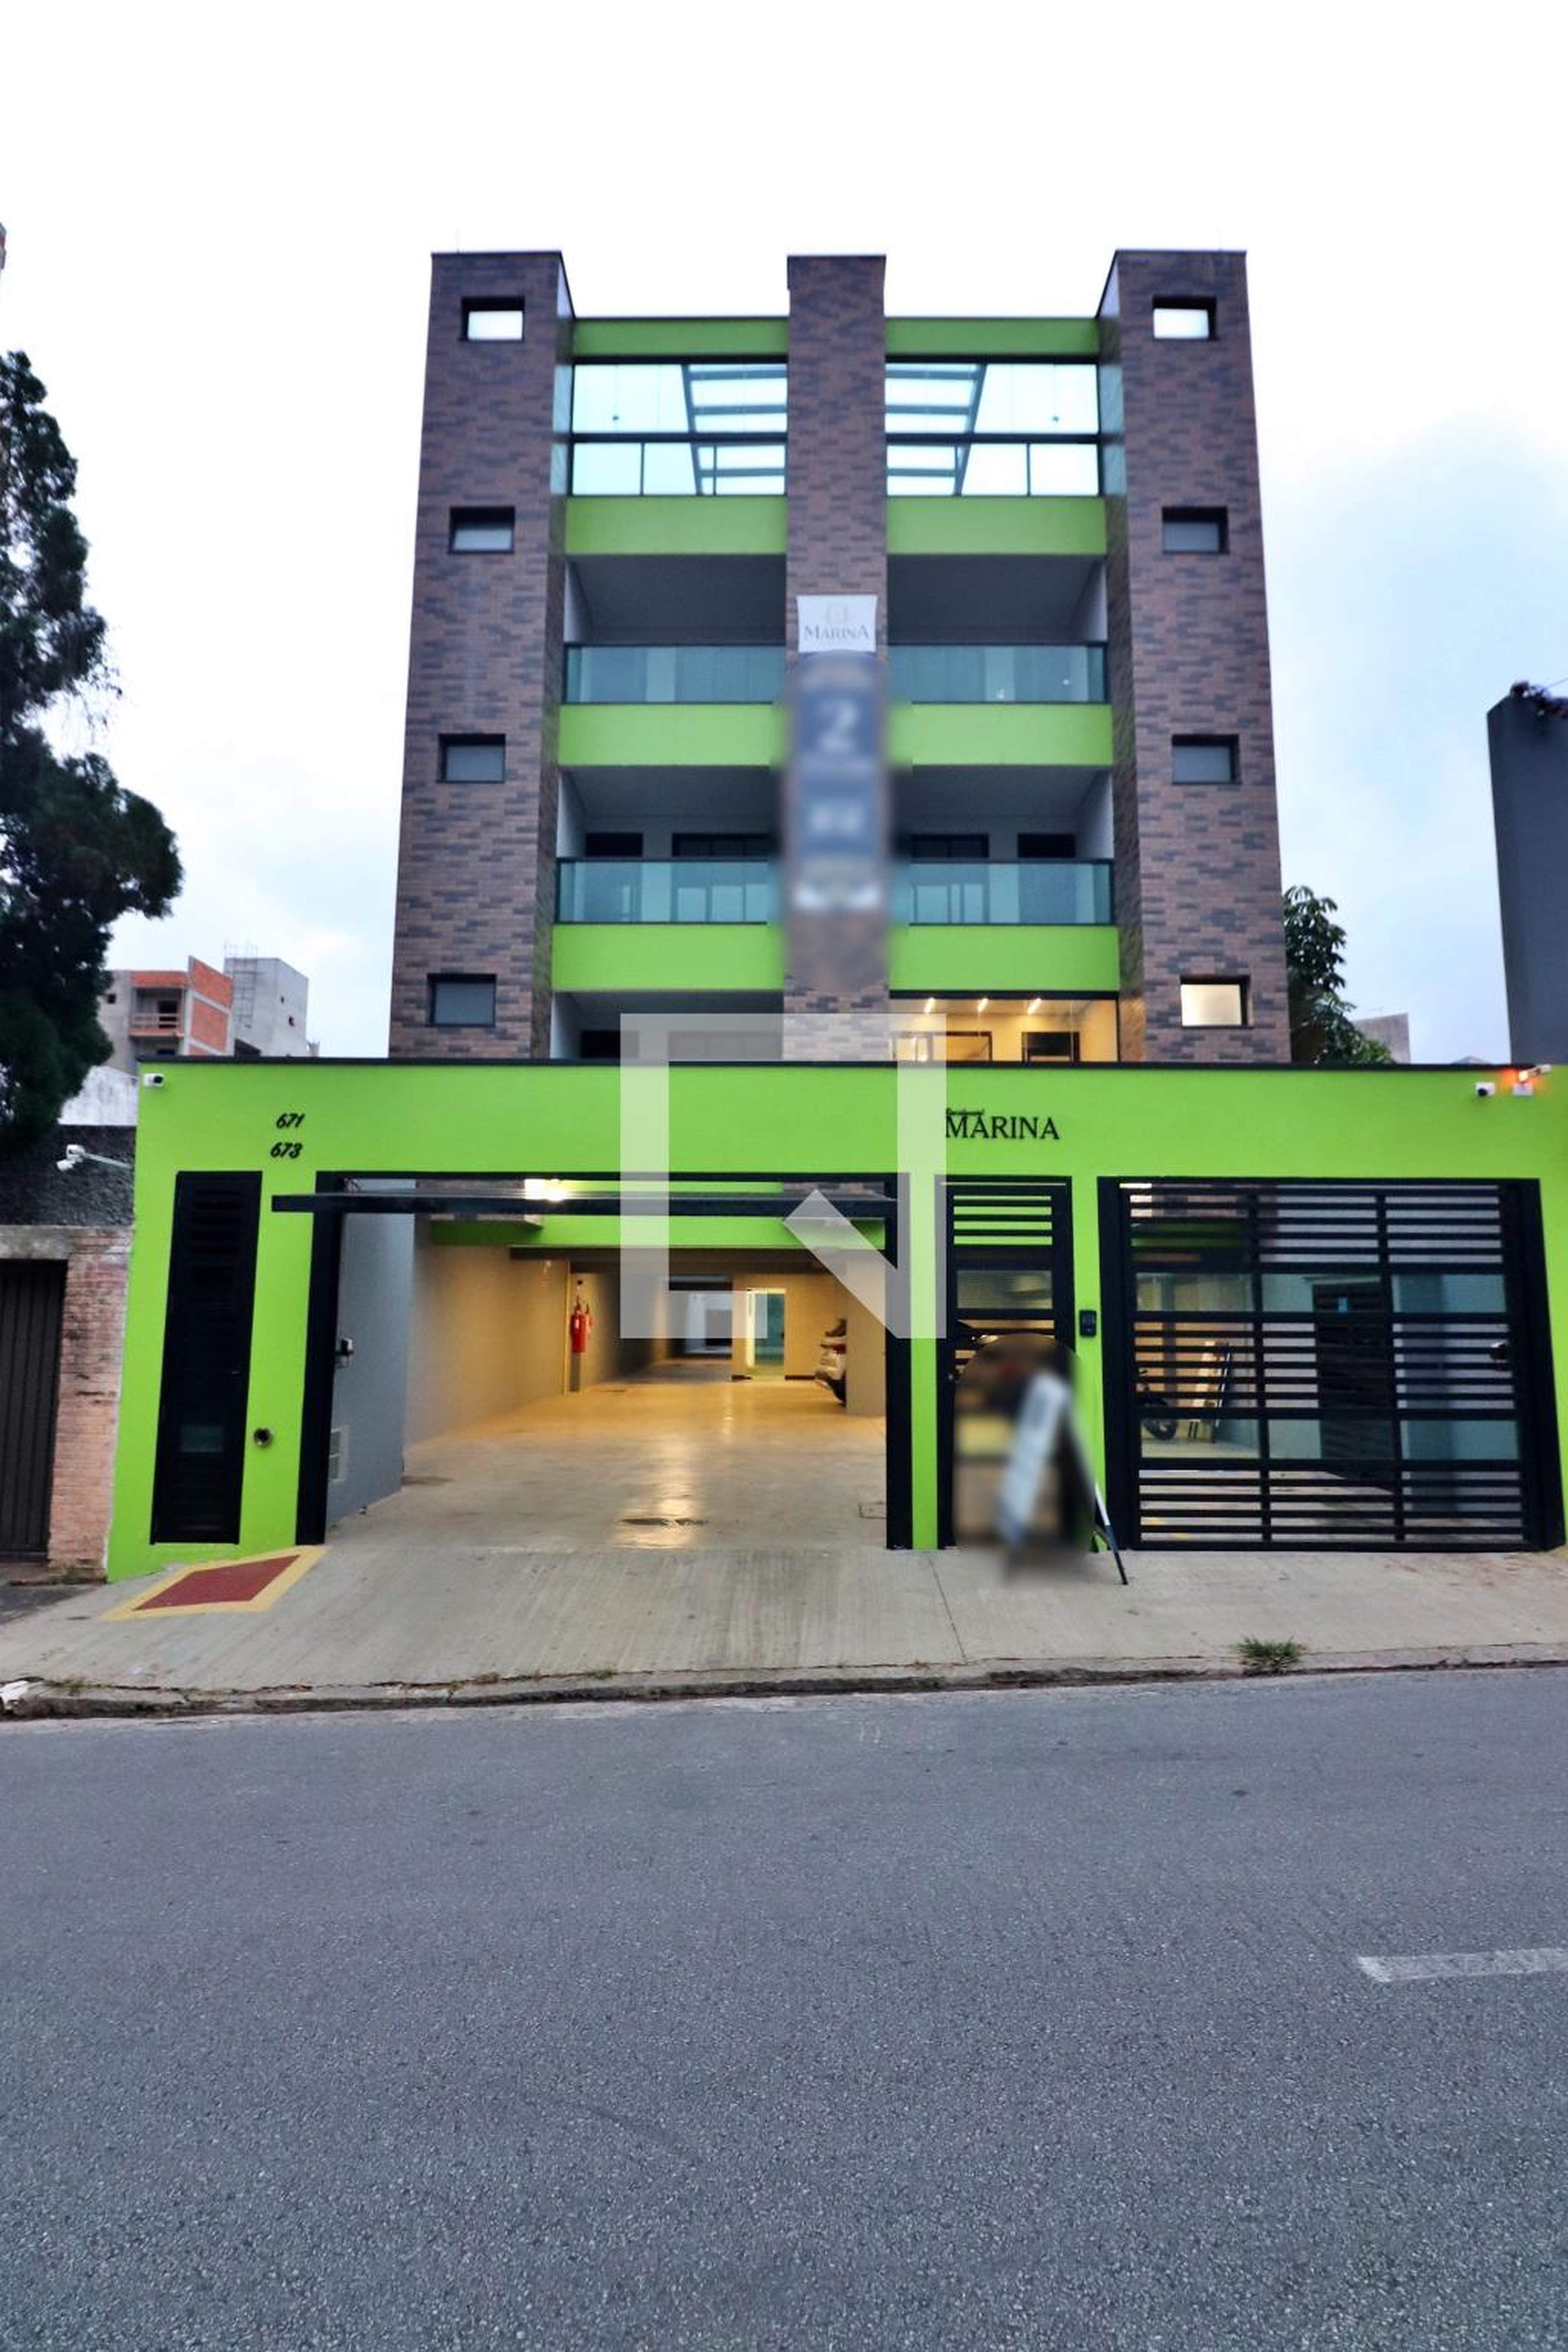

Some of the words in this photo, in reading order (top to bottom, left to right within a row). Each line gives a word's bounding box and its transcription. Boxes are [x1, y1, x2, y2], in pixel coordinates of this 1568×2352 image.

[276, 1113, 305, 1129] 671
[946, 1115, 1060, 1139] MARINA
[270, 1142, 303, 1159] 673
